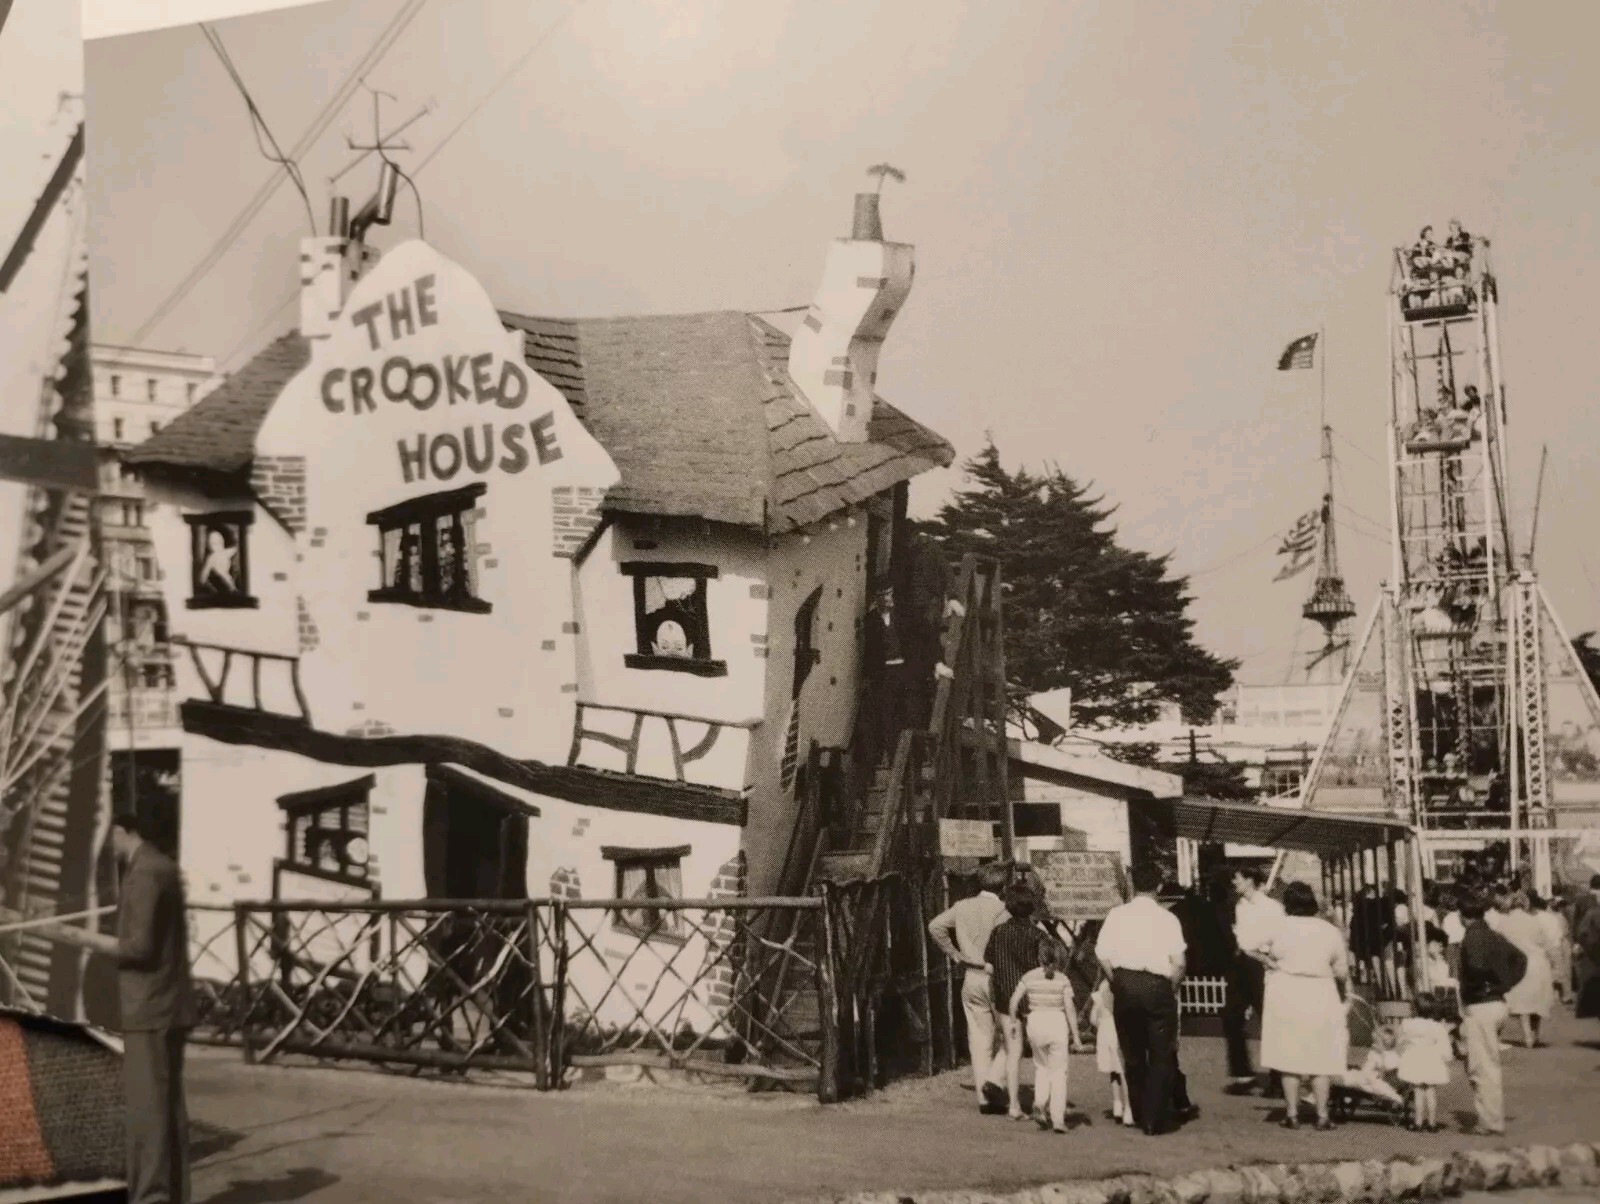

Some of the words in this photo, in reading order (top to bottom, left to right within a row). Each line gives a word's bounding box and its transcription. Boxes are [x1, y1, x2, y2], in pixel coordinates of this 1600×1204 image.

[352, 273, 438, 351] THE
[320, 352, 528, 415] CROOKED
[397, 411, 564, 483] HOUSE
